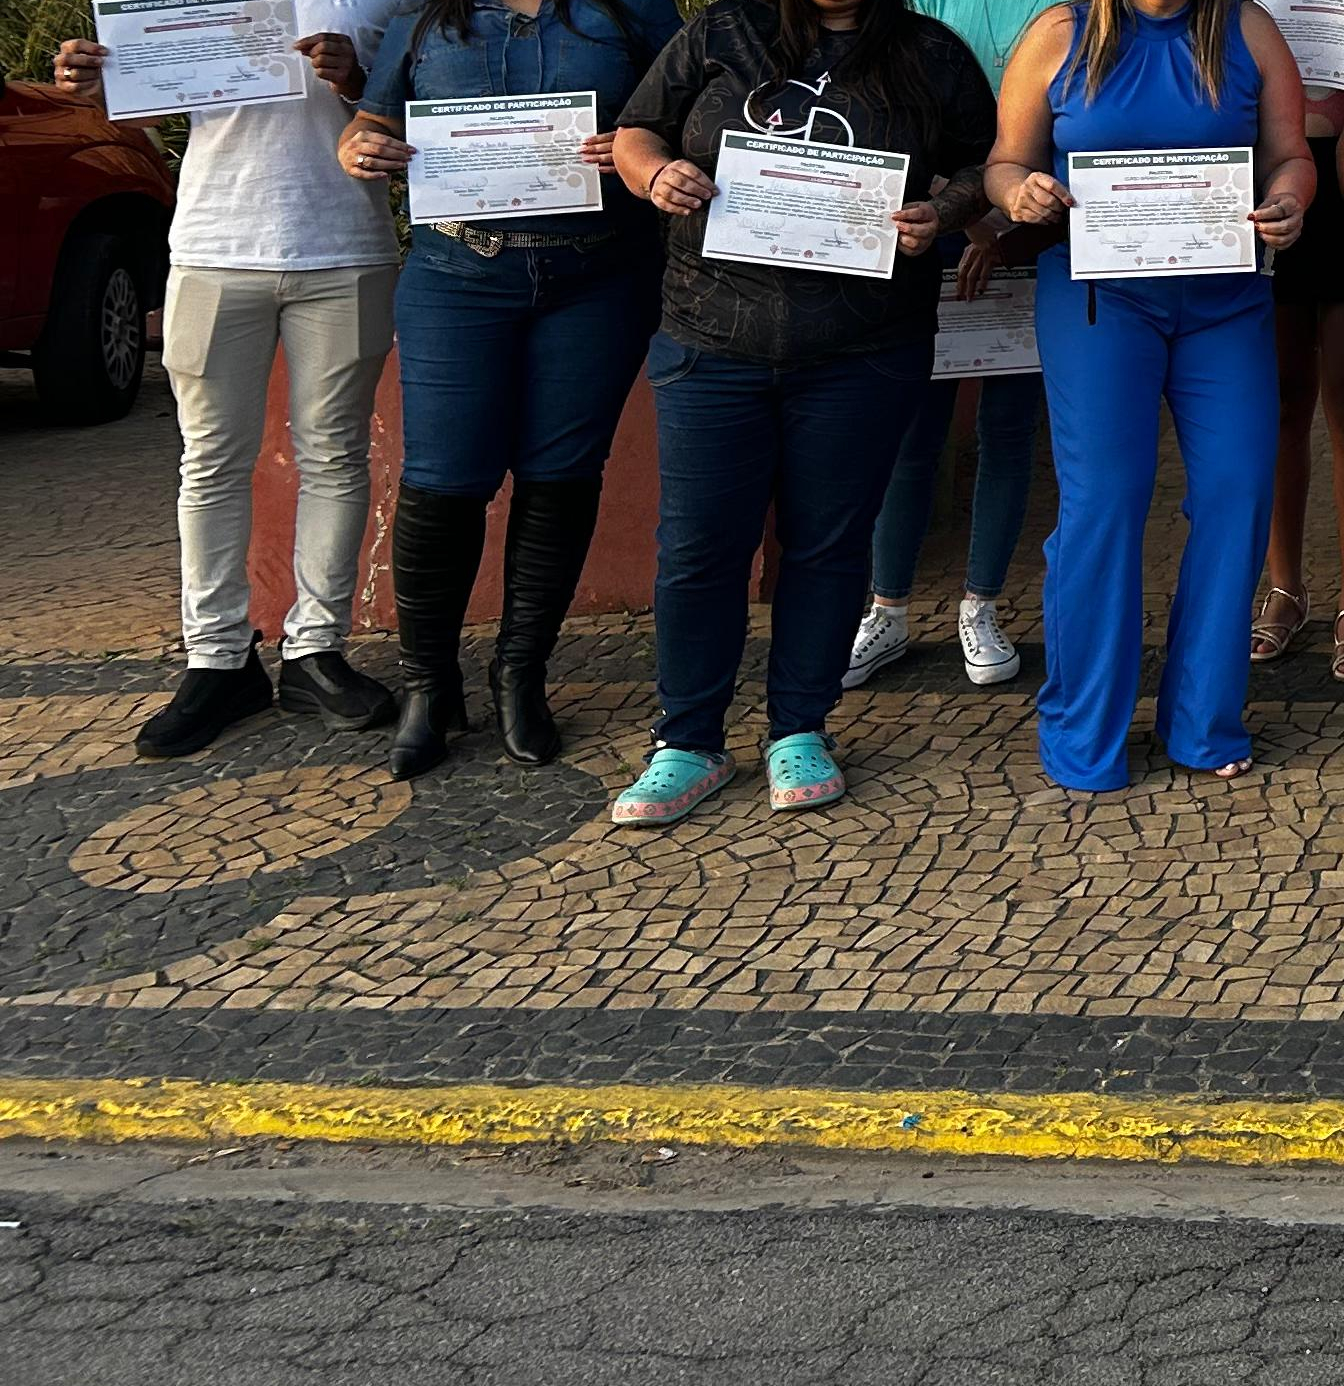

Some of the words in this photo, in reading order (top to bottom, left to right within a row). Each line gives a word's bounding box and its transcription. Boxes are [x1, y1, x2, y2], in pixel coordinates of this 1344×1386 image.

[432, 103, 491, 114] CERTIFICADO
[508, 98, 571, 109] PARTICIPAÇÃO
[747, 141, 804, 155] CERTIFICADO
[807, 148, 819, 157] DE
[821, 150, 884, 165] PARTICIPAÇÃO
[1093, 157, 1150, 165] CERTIFICADO
[1166, 154, 1229, 163] PARTICIPAÇÃO
